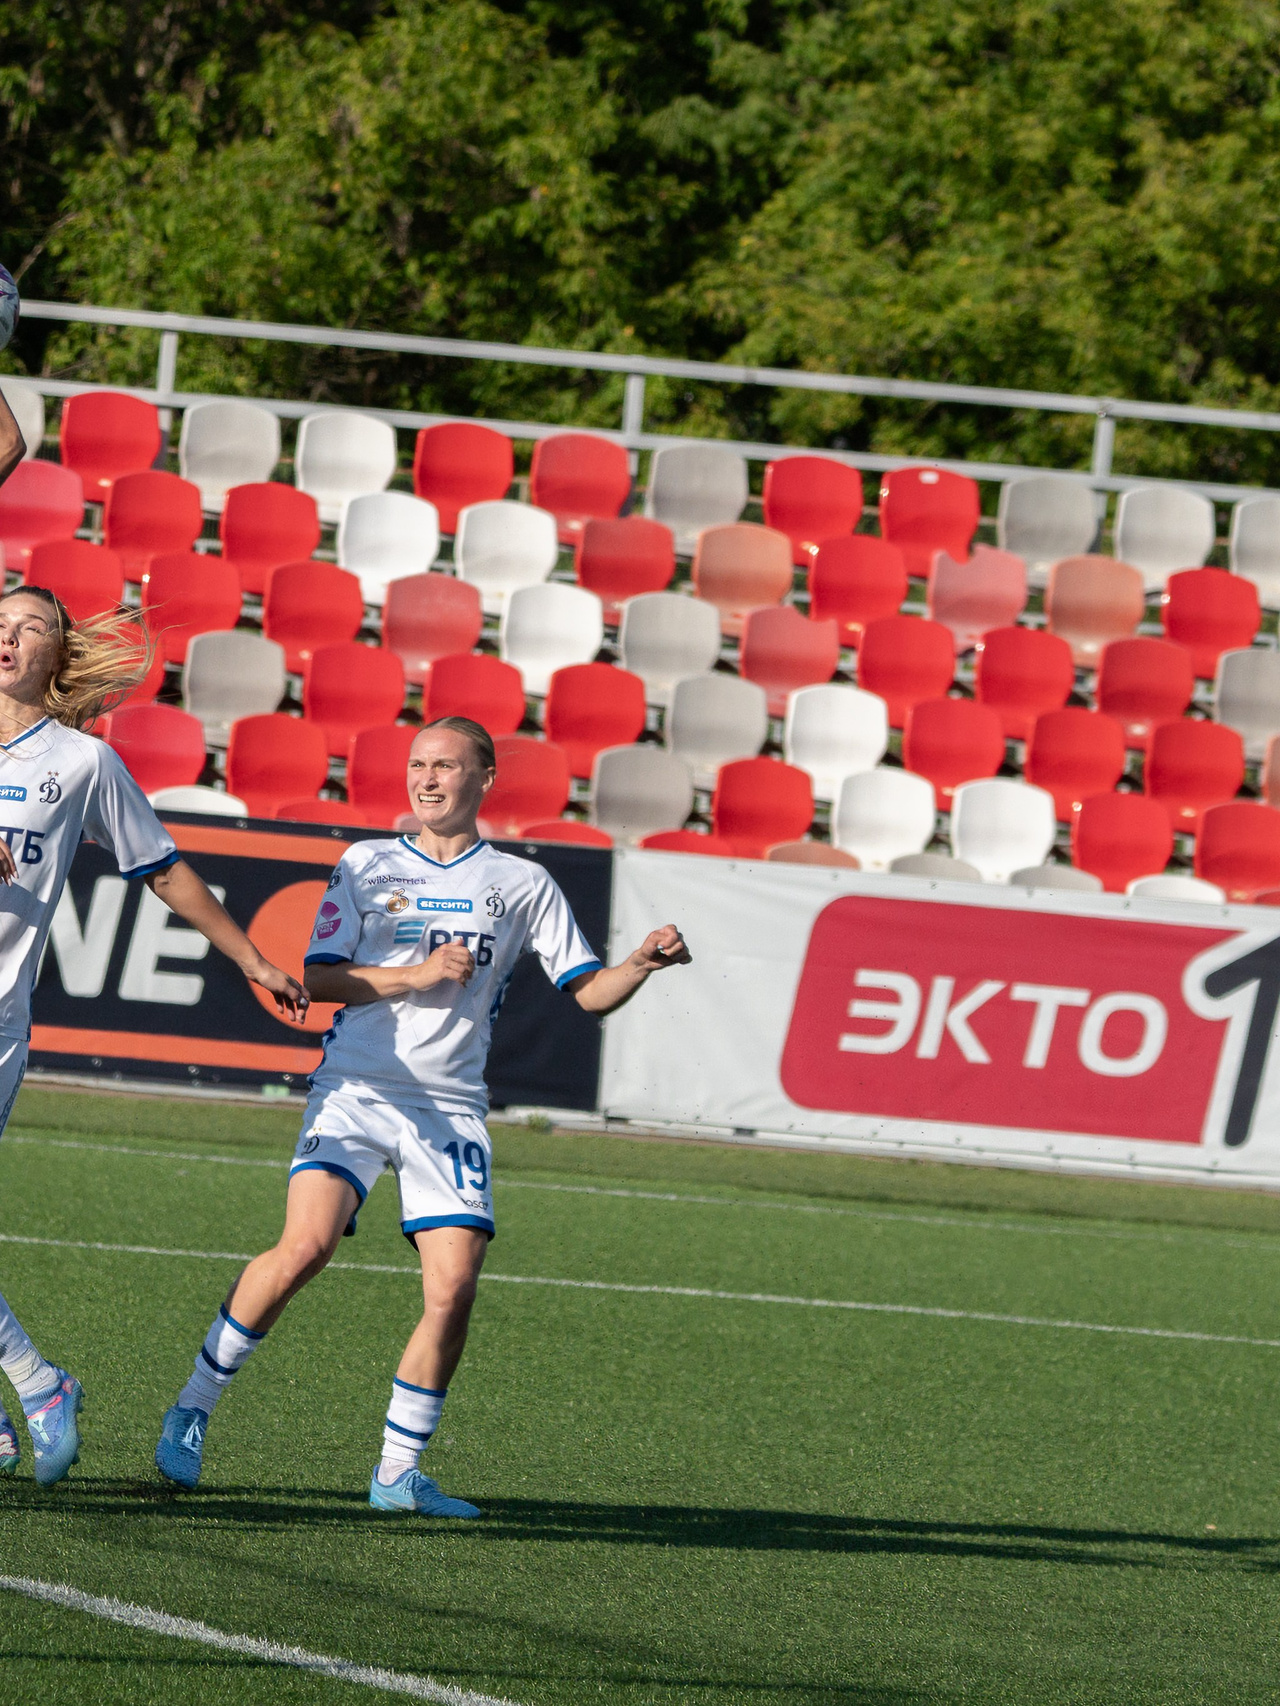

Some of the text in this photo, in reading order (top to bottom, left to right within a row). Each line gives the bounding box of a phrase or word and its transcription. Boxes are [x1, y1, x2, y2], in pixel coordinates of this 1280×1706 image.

[367, 875, 427, 886] wildberries
[419, 900, 470, 910] БЕТСИТИ
[837, 968, 1170, 1078] ЭКТО
[443, 1141, 488, 1191] 19
